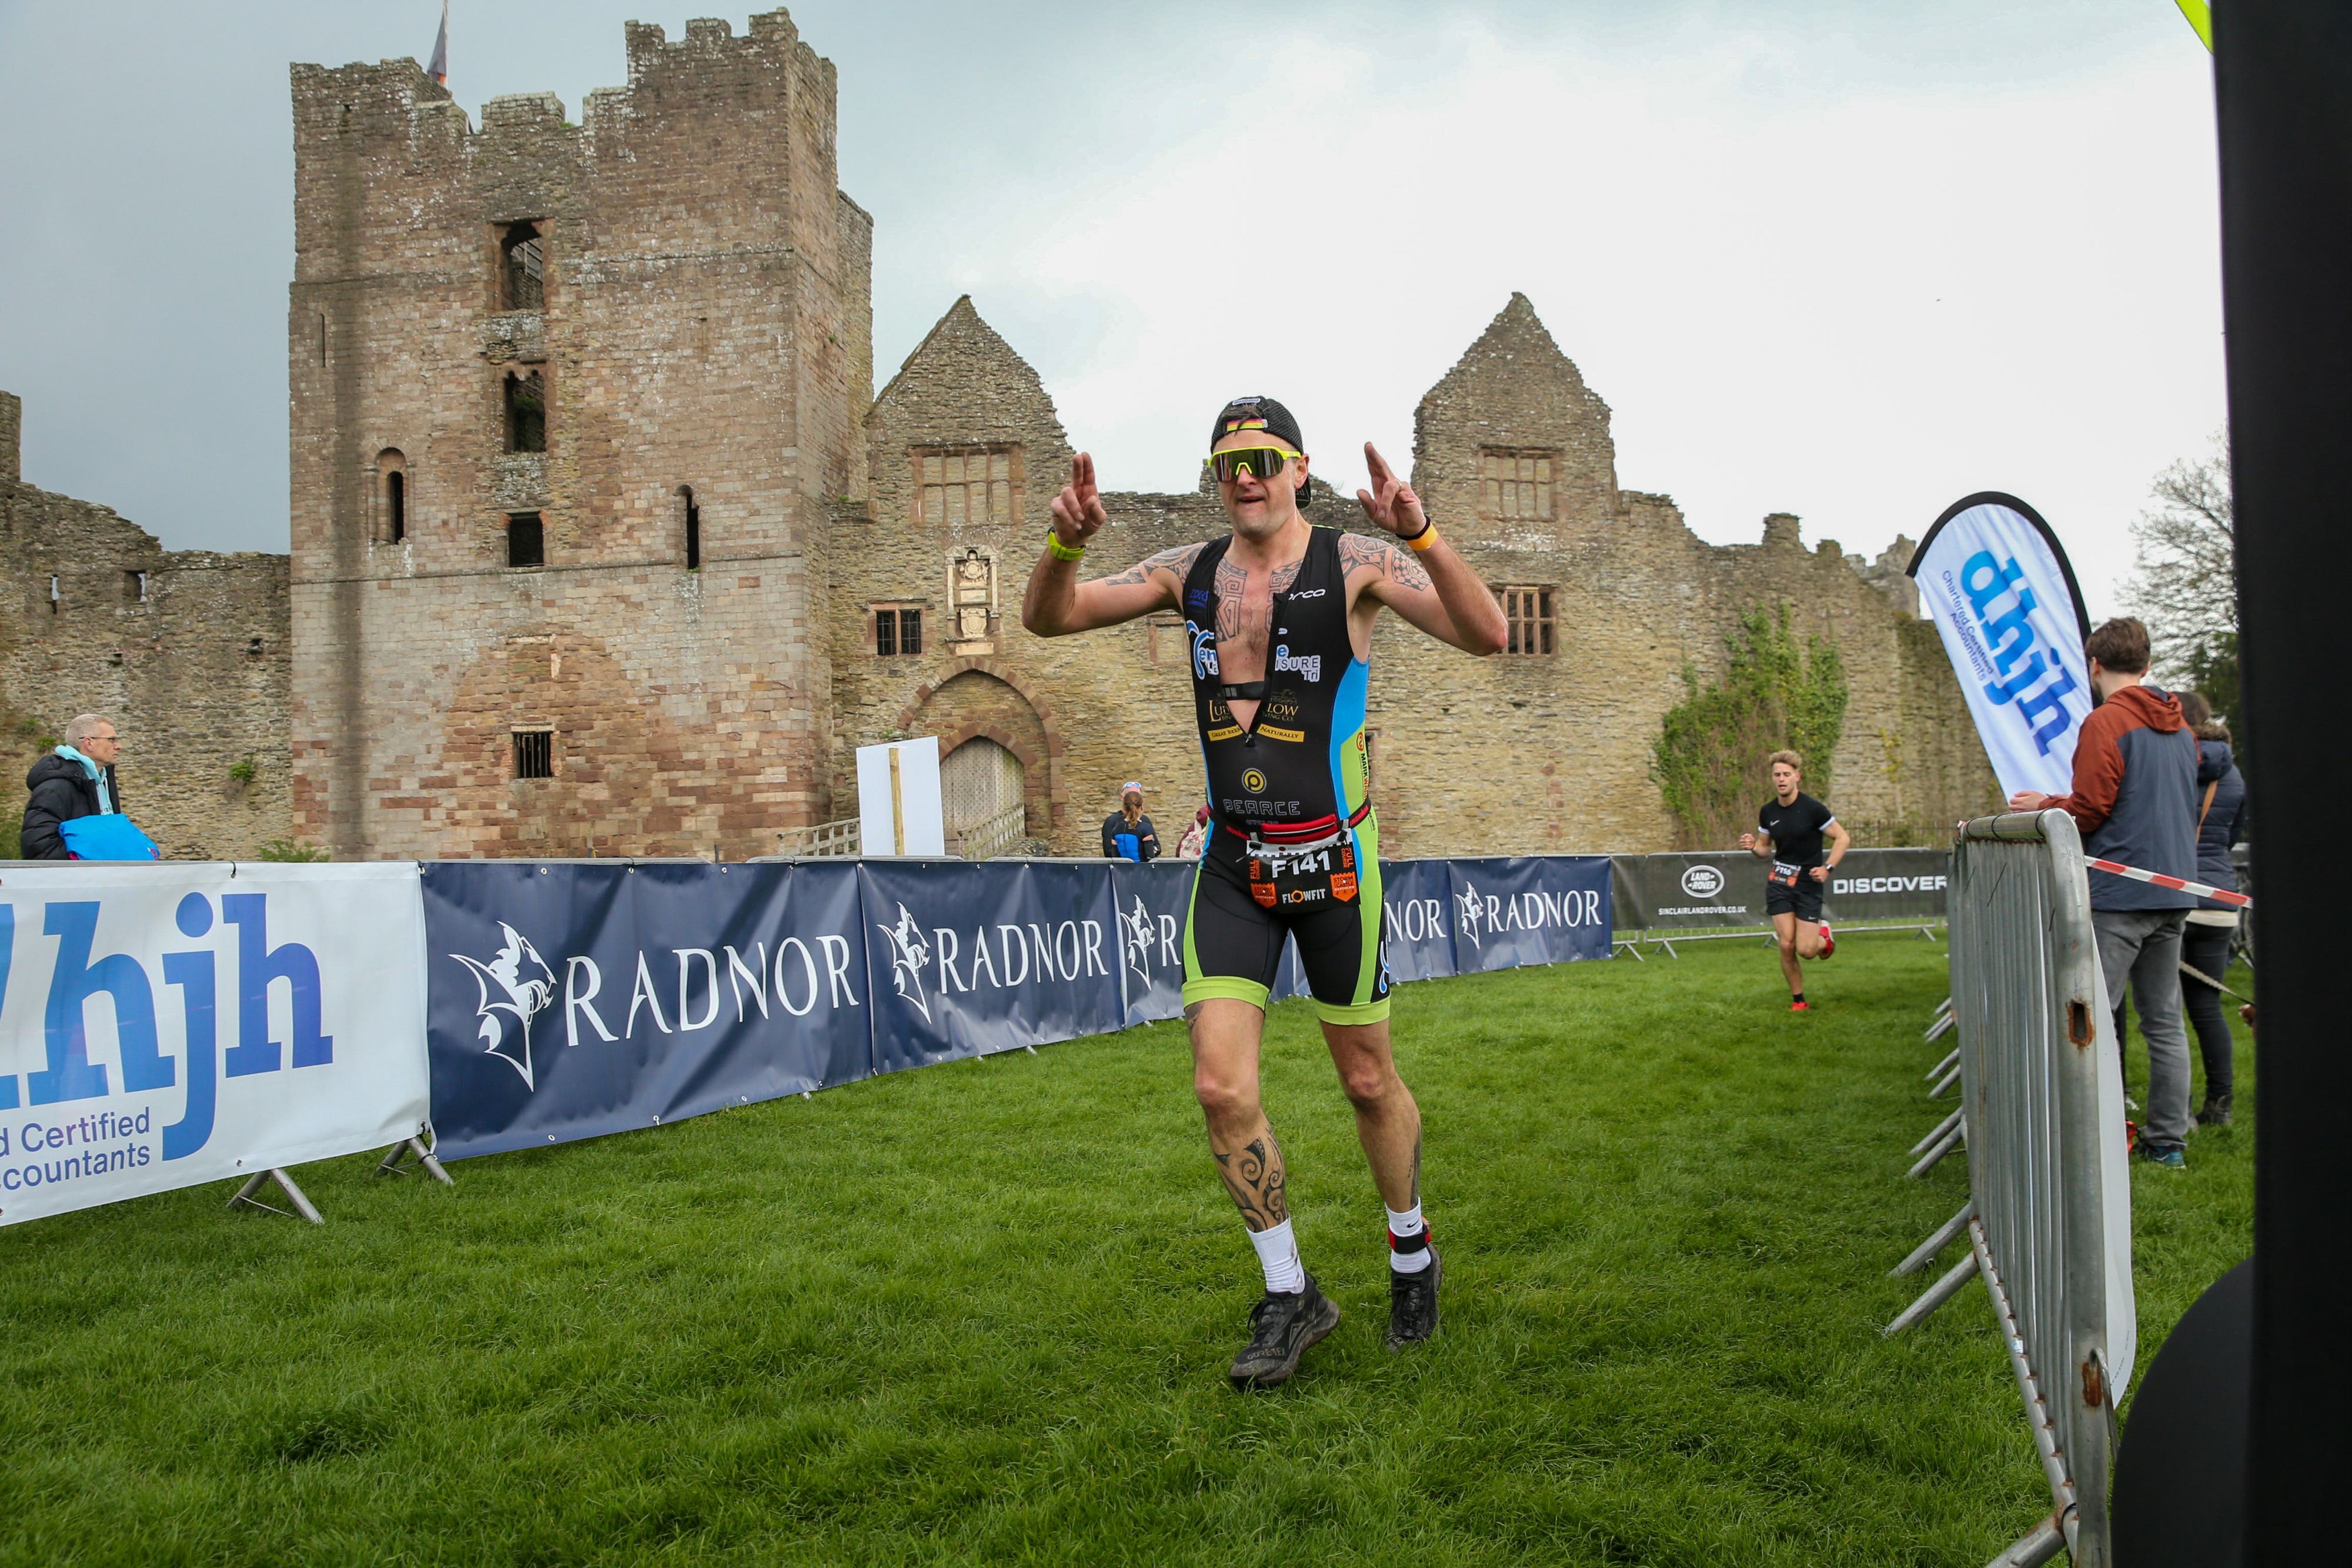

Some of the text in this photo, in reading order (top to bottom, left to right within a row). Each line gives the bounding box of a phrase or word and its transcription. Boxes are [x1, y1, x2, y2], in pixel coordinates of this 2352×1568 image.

[1942, 570, 1971, 626] Chartered
[1950, 612, 1987, 681] Accountants
[1304, 669, 1318, 680] Tri
[1261, 726, 1299, 738] NATURALLY
[1223, 799, 1301, 816] PEARCE
[1272, 850, 1331, 878] F141
[1345, 847, 1354, 868] FULL
[1690, 872, 1710, 881] LAND
[1692, 881, 1716, 890] ROVER
[1282, 888, 1326, 904] FLOWFIT
[1658, 905, 1747, 915] SINCLAIRLANDROVER.CO.UK
[1384, 899, 1447, 942] NOR
[1485, 890, 1603, 933] RADNOR
[933, 920, 1109, 994] RADNOR
[565, 935, 859, 1047] RADNOR
[21, 1106, 150, 1152] Certified
[0, 1142, 151, 1191] countants
